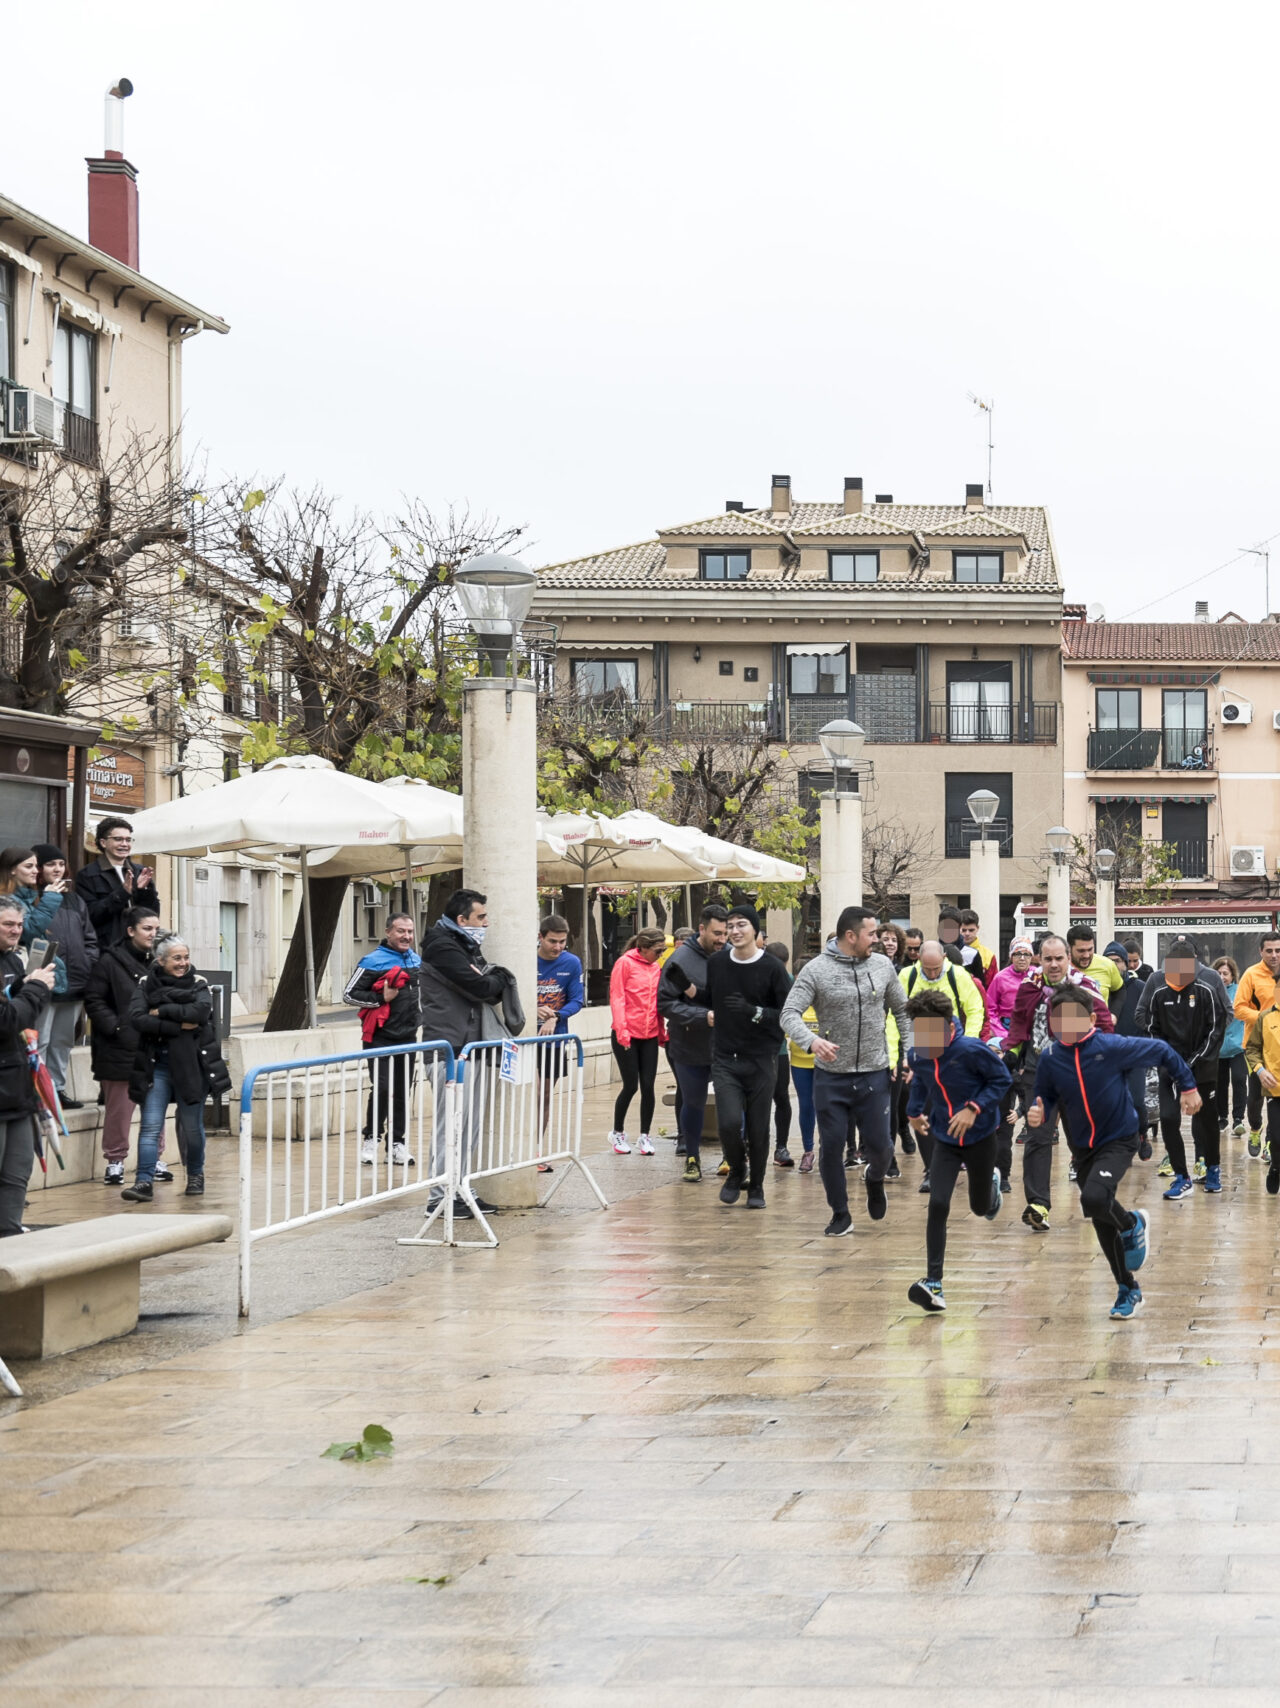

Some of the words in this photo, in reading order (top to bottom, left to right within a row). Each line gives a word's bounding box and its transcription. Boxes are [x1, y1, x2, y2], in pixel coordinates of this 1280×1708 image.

[85, 766, 133, 787] rimavera
[93, 784, 116, 799] burger
[359, 830, 389, 839] Mahou
[1142, 917, 1186, 925] RETORNO
